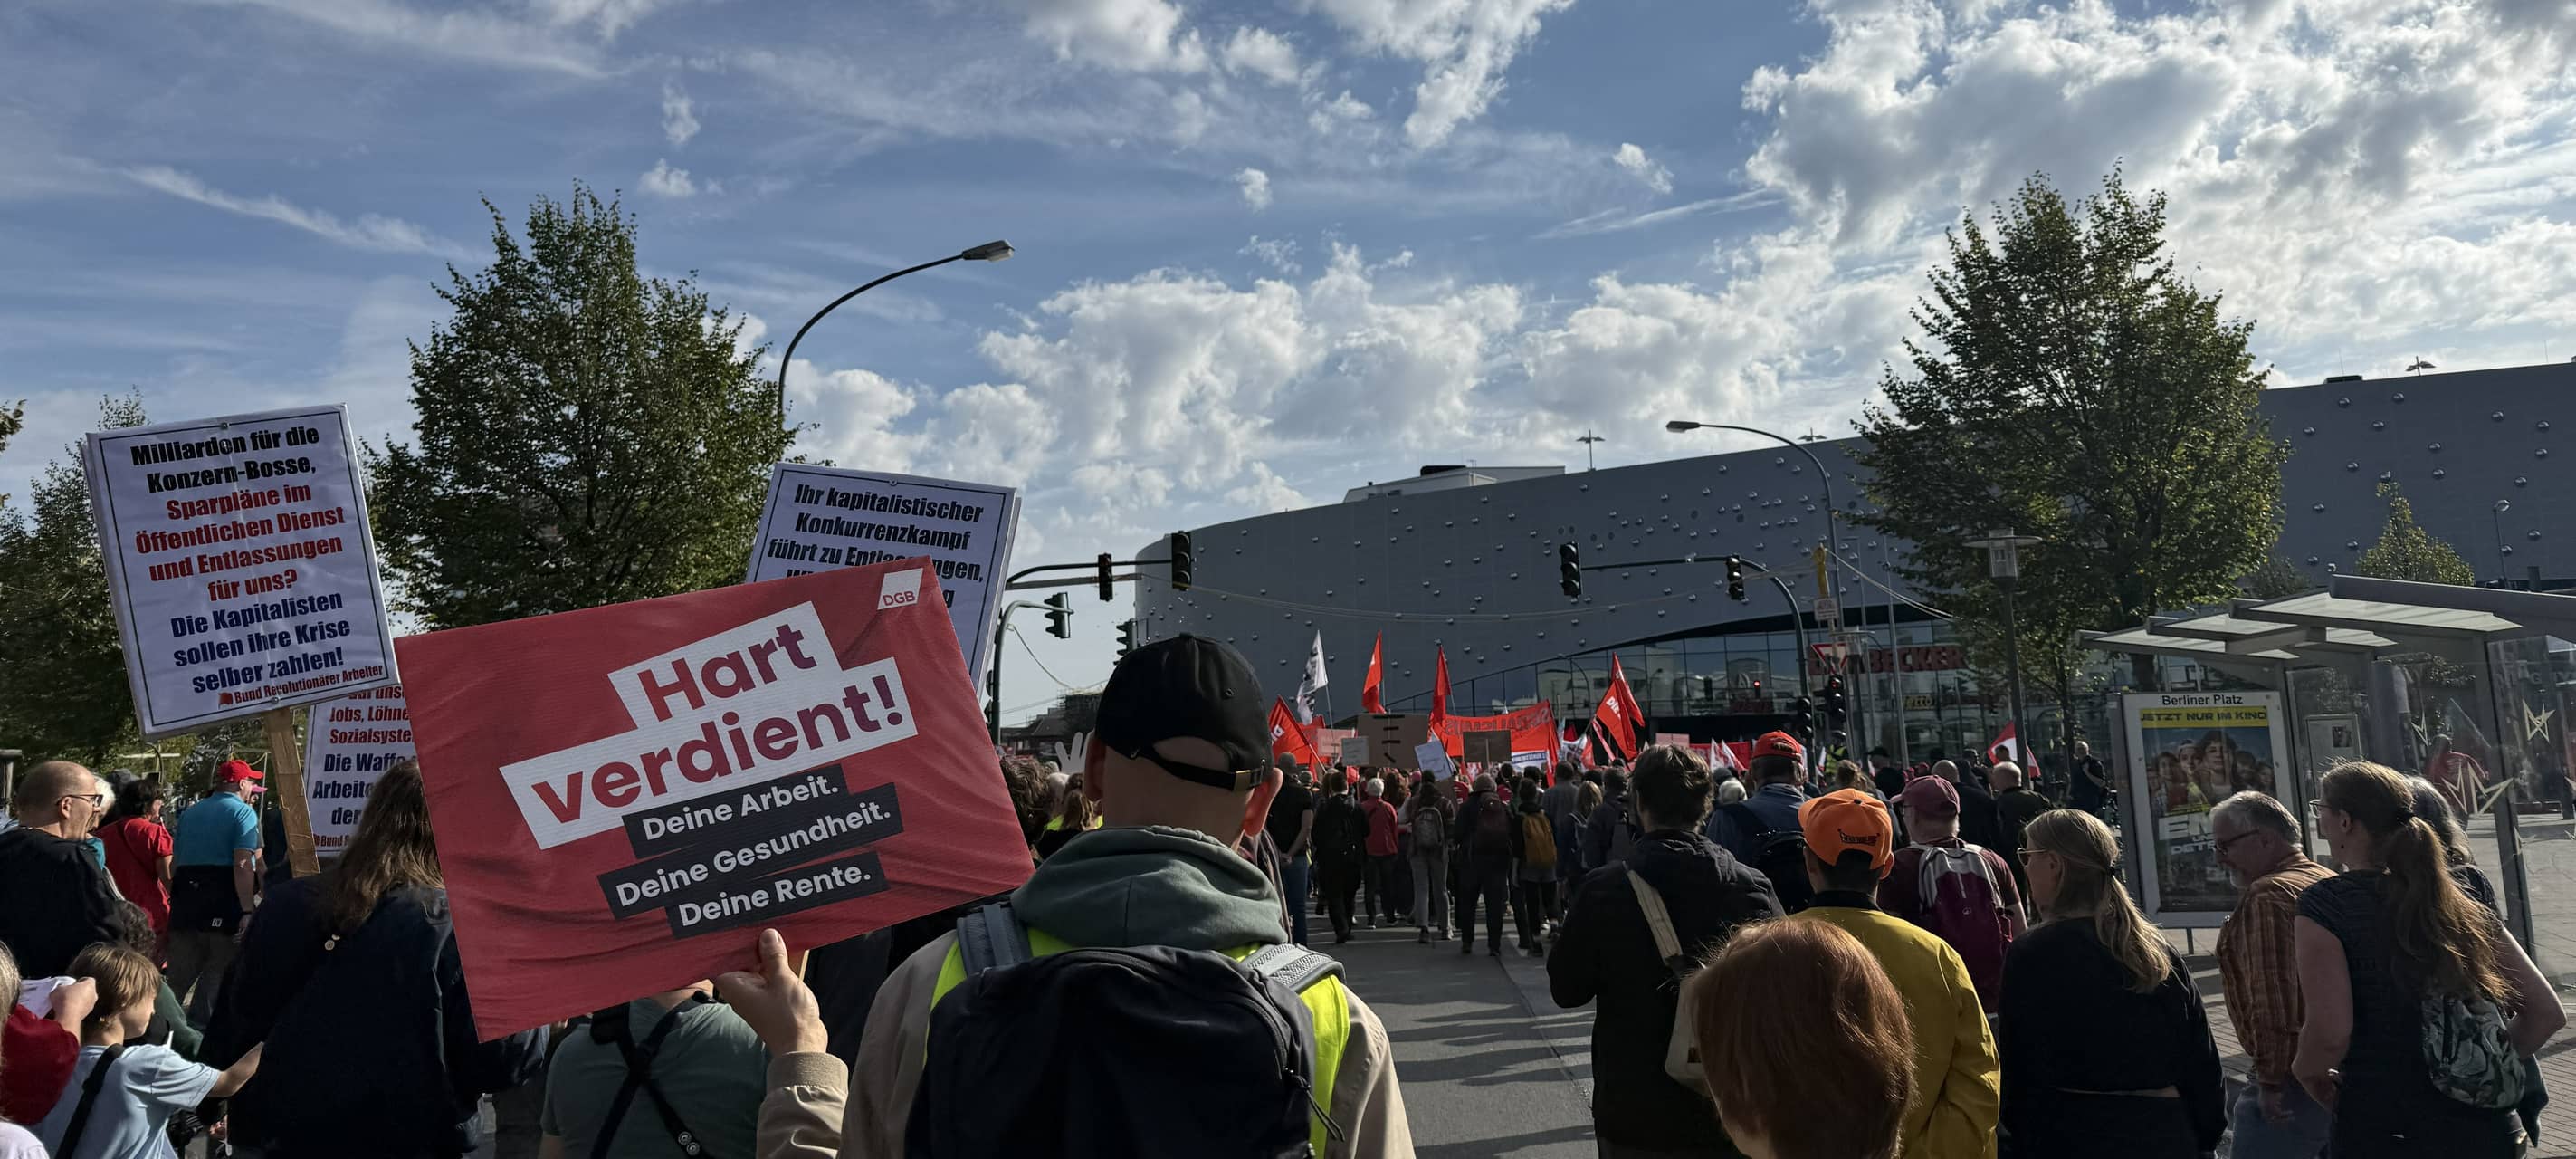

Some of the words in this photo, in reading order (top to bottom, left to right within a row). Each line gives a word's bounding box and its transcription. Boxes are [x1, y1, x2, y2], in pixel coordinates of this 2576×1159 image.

[130, 437, 245, 465] Milliarden
[250, 429, 281, 450] für
[286, 426, 319, 446] die
[147, 455, 317, 493] Konzern-Bosse,
[167, 487, 280, 520] Sparpläne
[283, 484, 312, 503] im
[795, 484, 824, 503] Ihr
[826, 487, 984, 522] kapitalistischer
[136, 521, 273, 553] Öffentlichen
[277, 505, 346, 534] Dienst
[795, 512, 971, 550] Konkurrenzkampf
[149, 559, 193, 582] und
[197, 536, 343, 573] Entlassungen
[768, 539, 817, 561] führt
[819, 547, 842, 565] zu
[207, 581, 240, 601] für
[245, 569, 297, 595] uns?
[883, 591, 916, 606] DGB
[171, 614, 209, 637] Die
[214, 592, 343, 632] Kapitalisten
[174, 639, 244, 667] sollen
[247, 630, 292, 655] ihre
[297, 618, 351, 645] Krise
[193, 664, 263, 694] selber
[268, 647, 344, 679] zahlen!
[234, 686, 263, 704] Bund
[266, 671, 340, 697] Revolutionärer
[342, 664, 383, 685] Arbeiter
[637, 624, 816, 722] Hart
[329, 707, 364, 723] Jobs,
[2141, 713, 2182, 722] JETZT
[2187, 713, 2213, 721] NUR
[2218, 712, 2232, 721] IM
[2235, 711, 2266, 720] KINO
[2162, 695, 2209, 706] Berliner
[2214, 694, 2243, 704] Platz
[329, 728, 414, 745] Sozialsyste
[531, 675, 903, 824] verdient!
[324, 753, 351, 771] Die
[642, 802, 733, 841] Deine
[740, 775, 838, 819] Arbeit.
[616, 865, 708, 905] Deine
[714, 800, 892, 875] Gesundheit.
[678, 888, 770, 928] Deine
[776, 863, 872, 903] Rente.
